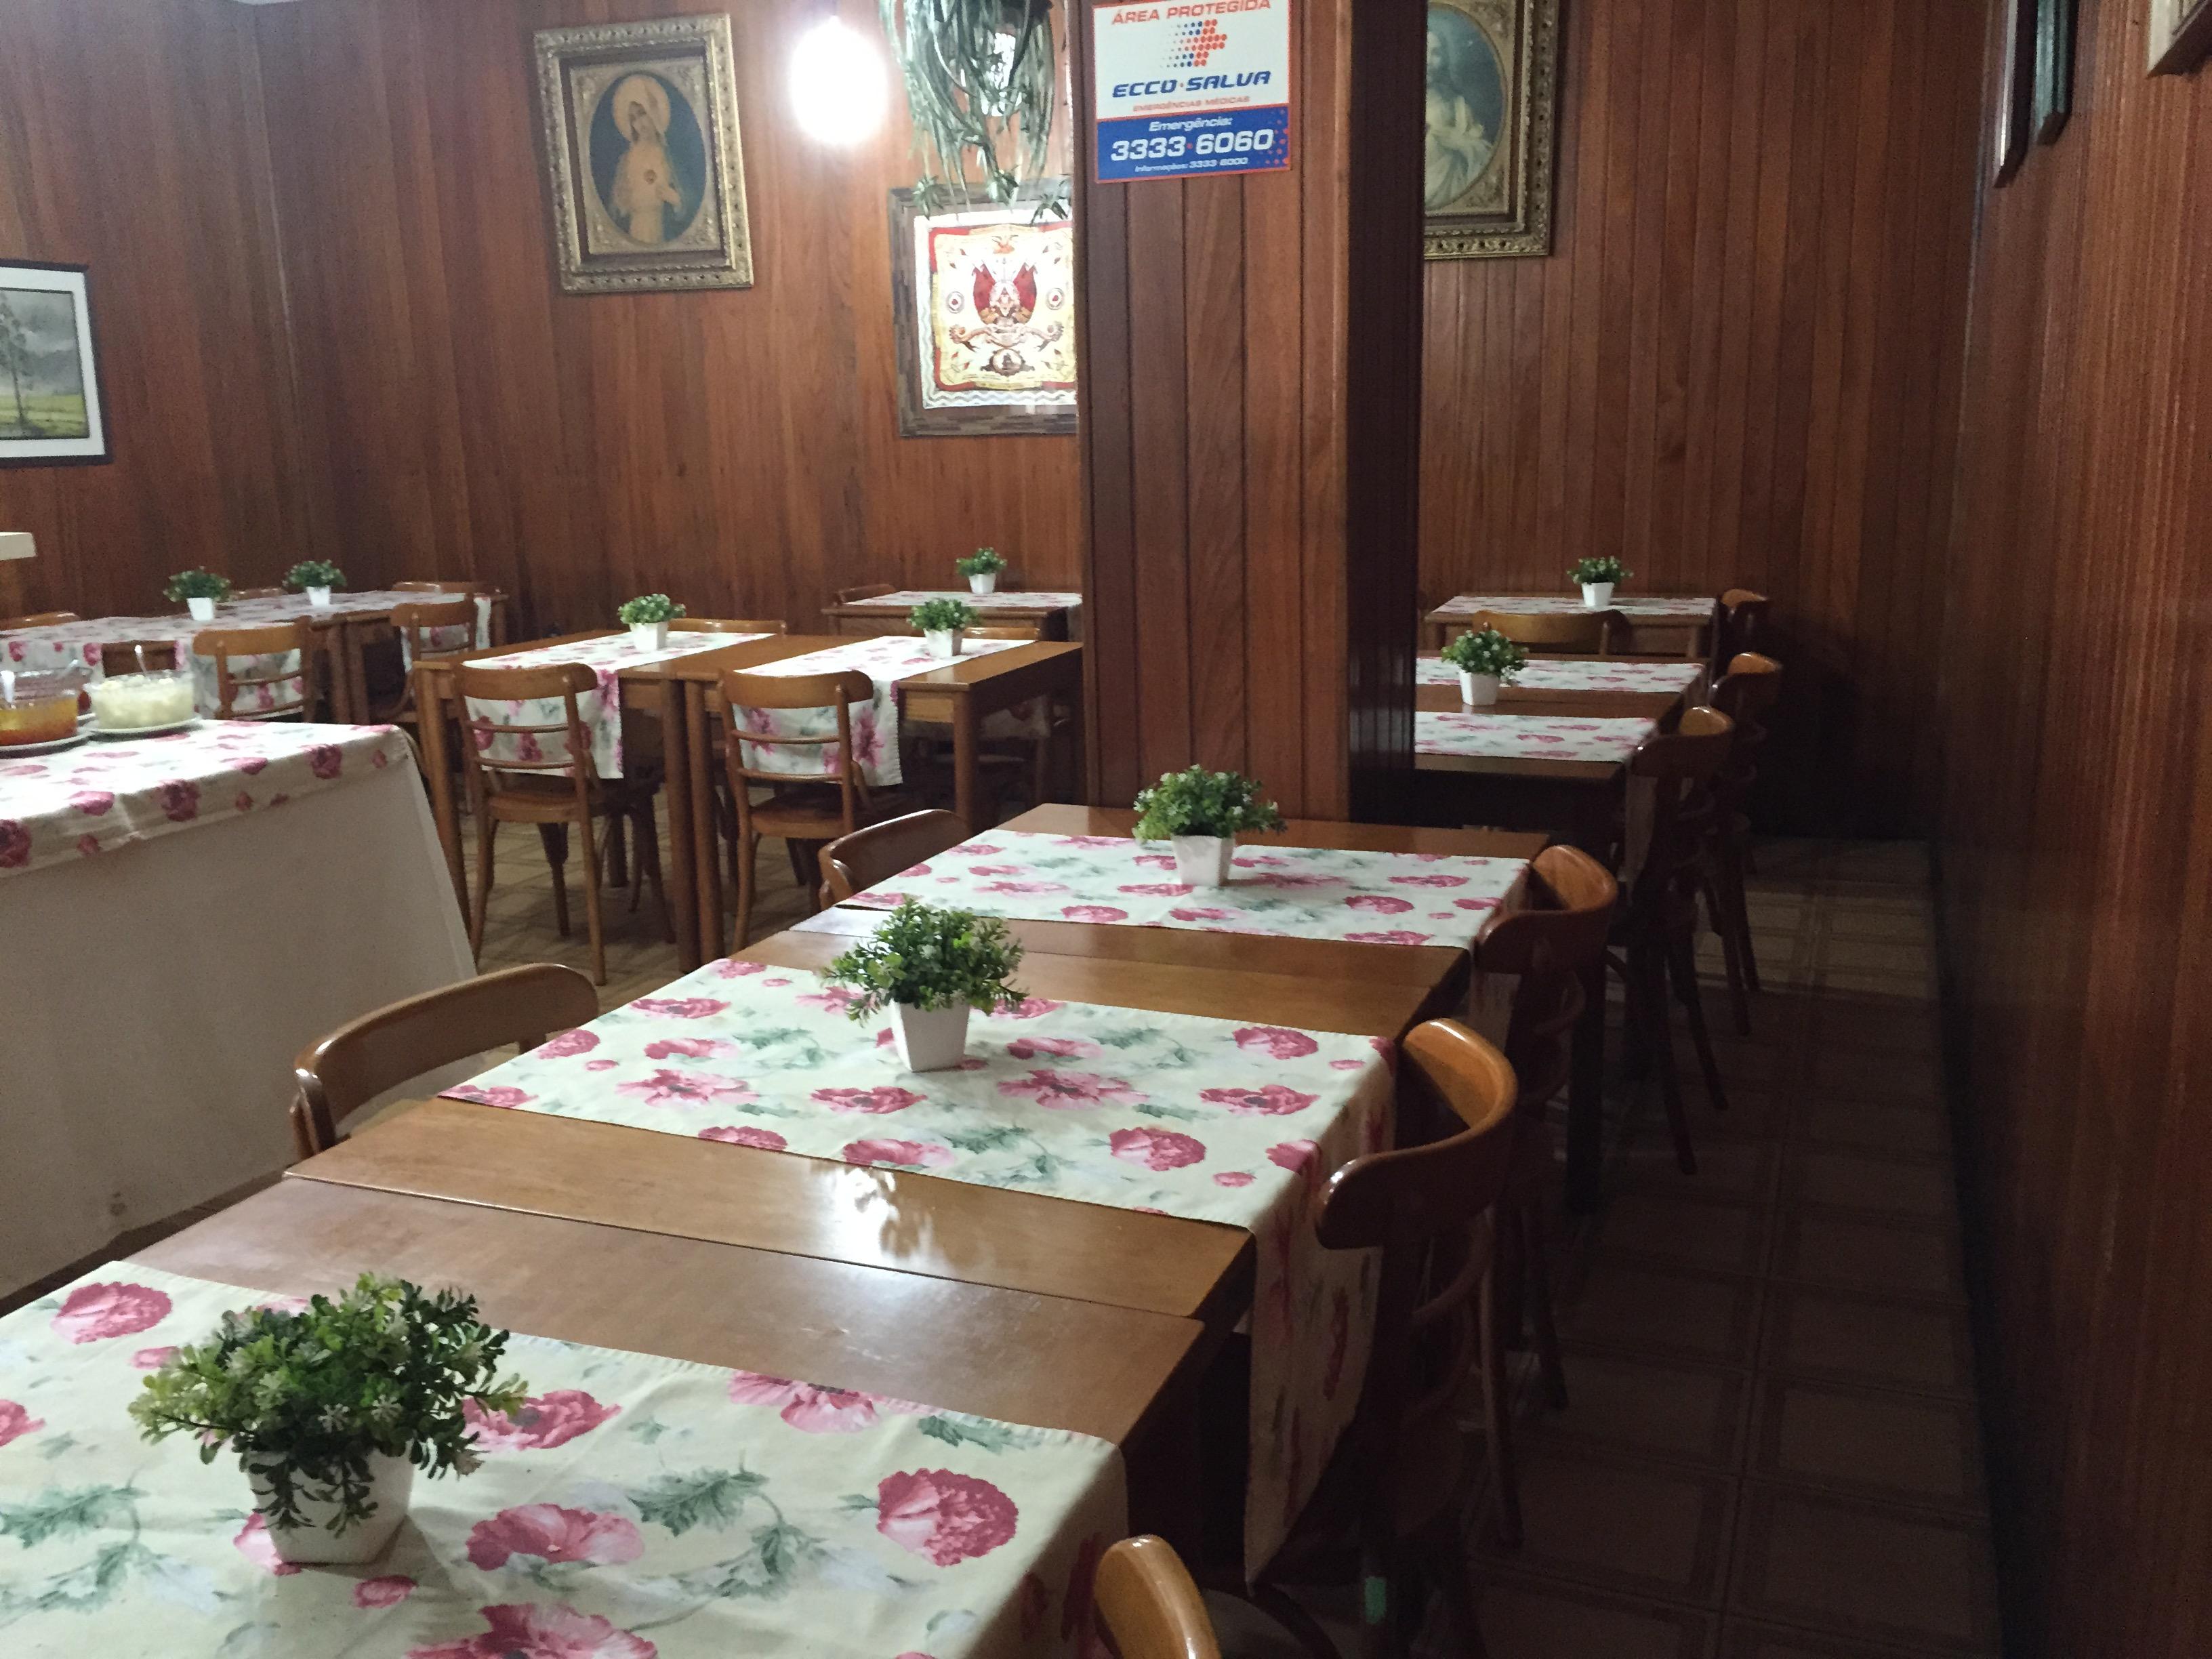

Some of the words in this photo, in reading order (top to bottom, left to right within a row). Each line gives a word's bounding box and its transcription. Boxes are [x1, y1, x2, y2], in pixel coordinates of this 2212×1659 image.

[1111, 8, 1160, 24] ÁREA
[1166, 0, 1271, 18] PROTEGIDA
[1111, 136, 1187, 161] 3333
[1195, 129, 1274, 155] 6060
